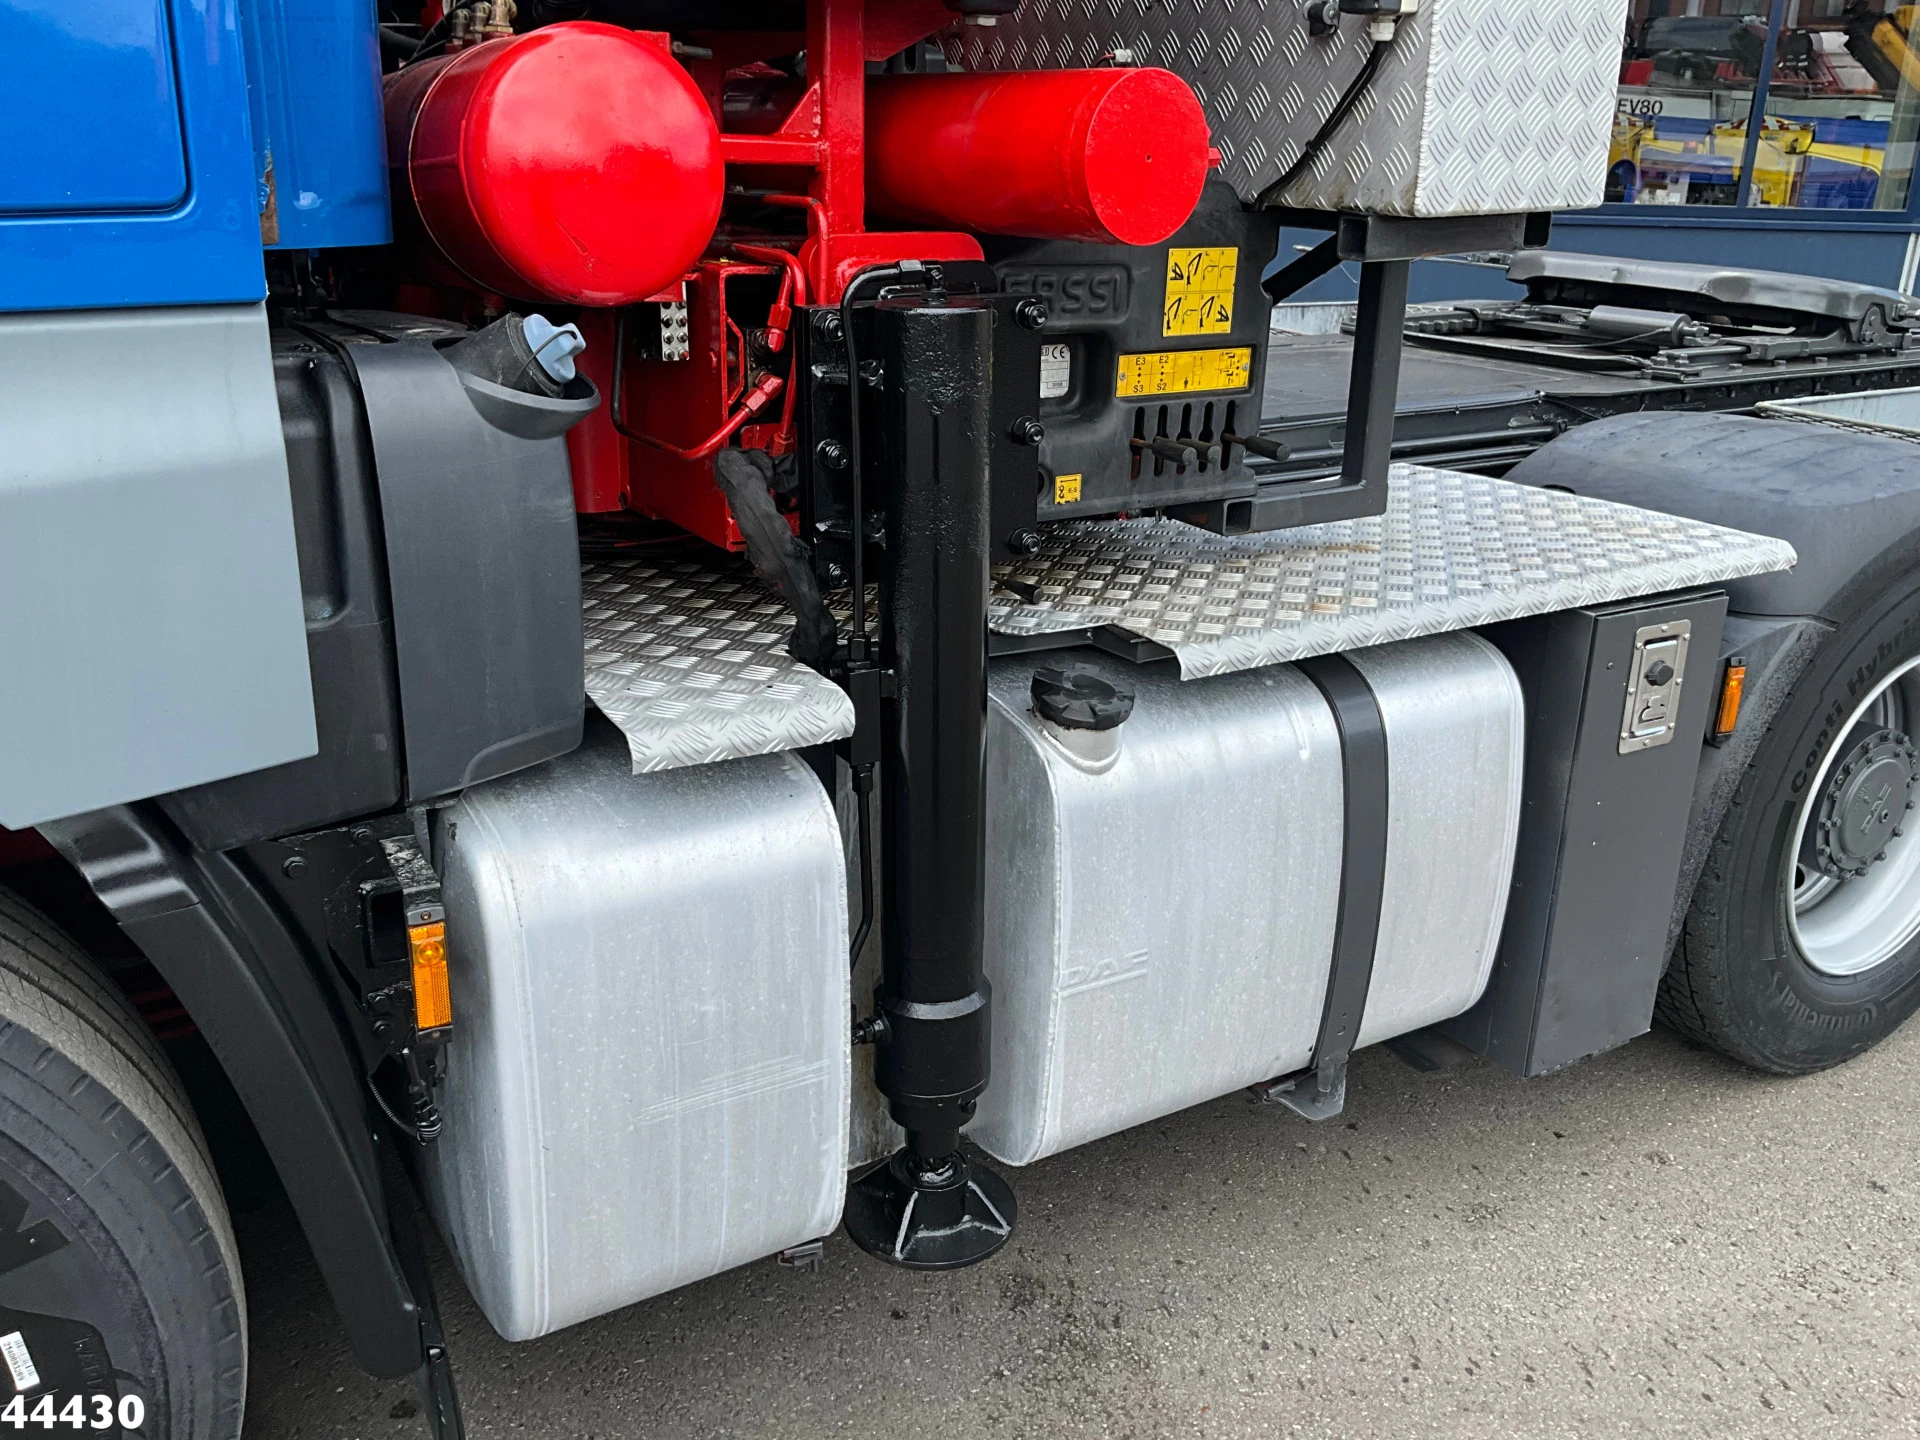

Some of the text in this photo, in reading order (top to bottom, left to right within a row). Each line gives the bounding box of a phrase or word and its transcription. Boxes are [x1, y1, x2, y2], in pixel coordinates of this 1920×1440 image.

[1616, 97, 1664, 116] EV80
[1135, 355, 1169, 366] E3 E2
[1133, 382, 1167, 393] S3 S2
[1790, 610, 1920, 794] Conti Hybri
[1774, 983, 1878, 1032] Continental
